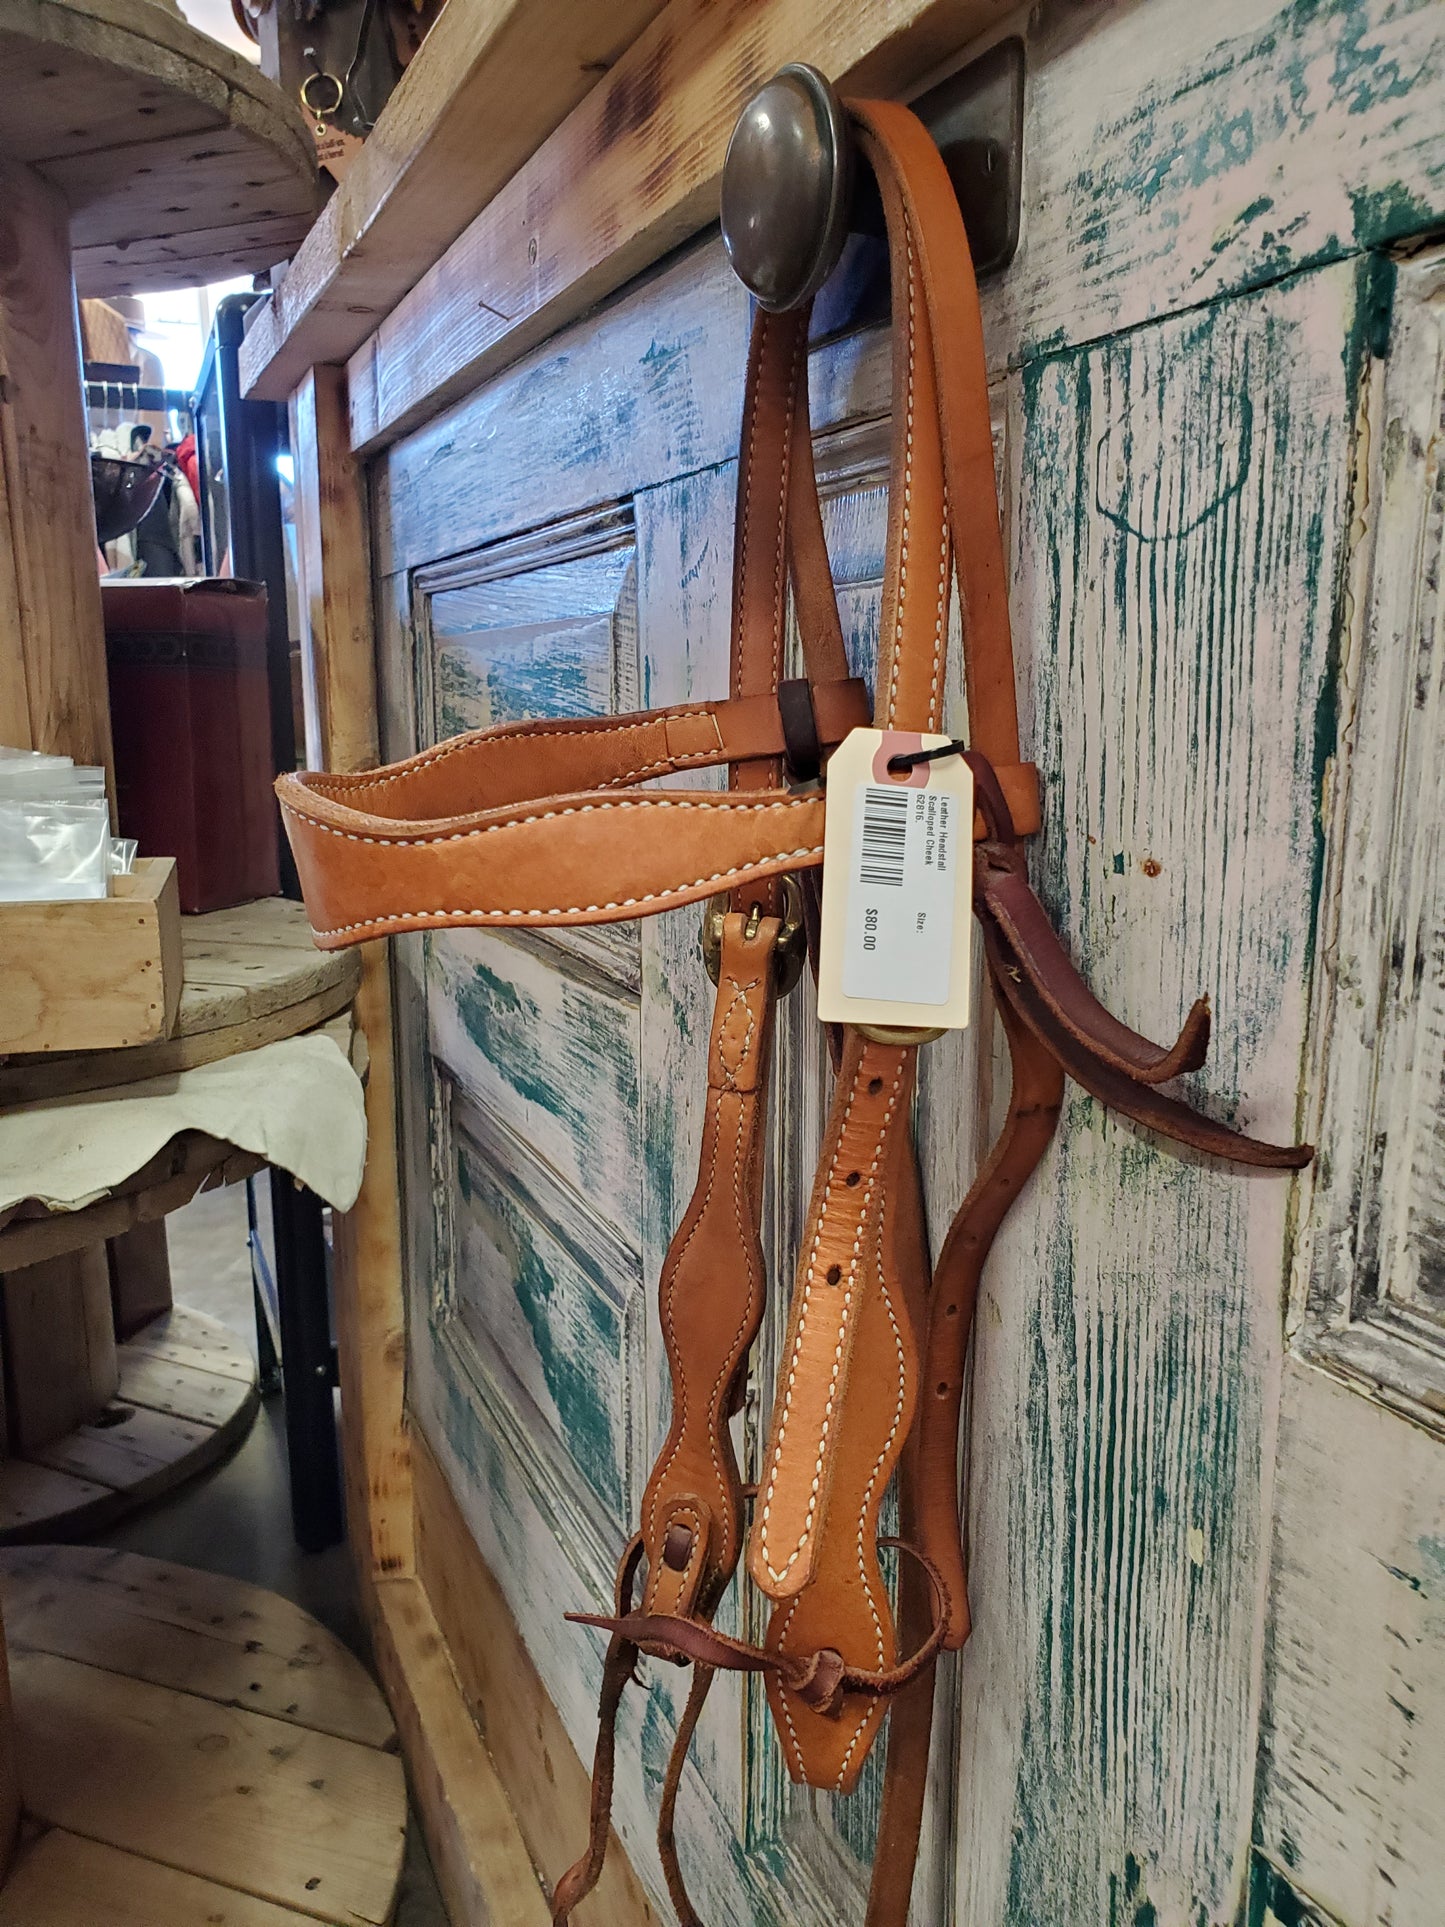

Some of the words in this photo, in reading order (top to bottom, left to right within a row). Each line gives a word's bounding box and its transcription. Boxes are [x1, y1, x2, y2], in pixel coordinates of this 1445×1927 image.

[925, 795, 937, 837] Scalloped
[940, 797, 950, 829] Leather
[924, 839, 935, 866] Cheek
[937, 832, 949, 871] Headstall
[863, 908, 878, 951] $80.00
[916, 912, 926, 934] Size:
